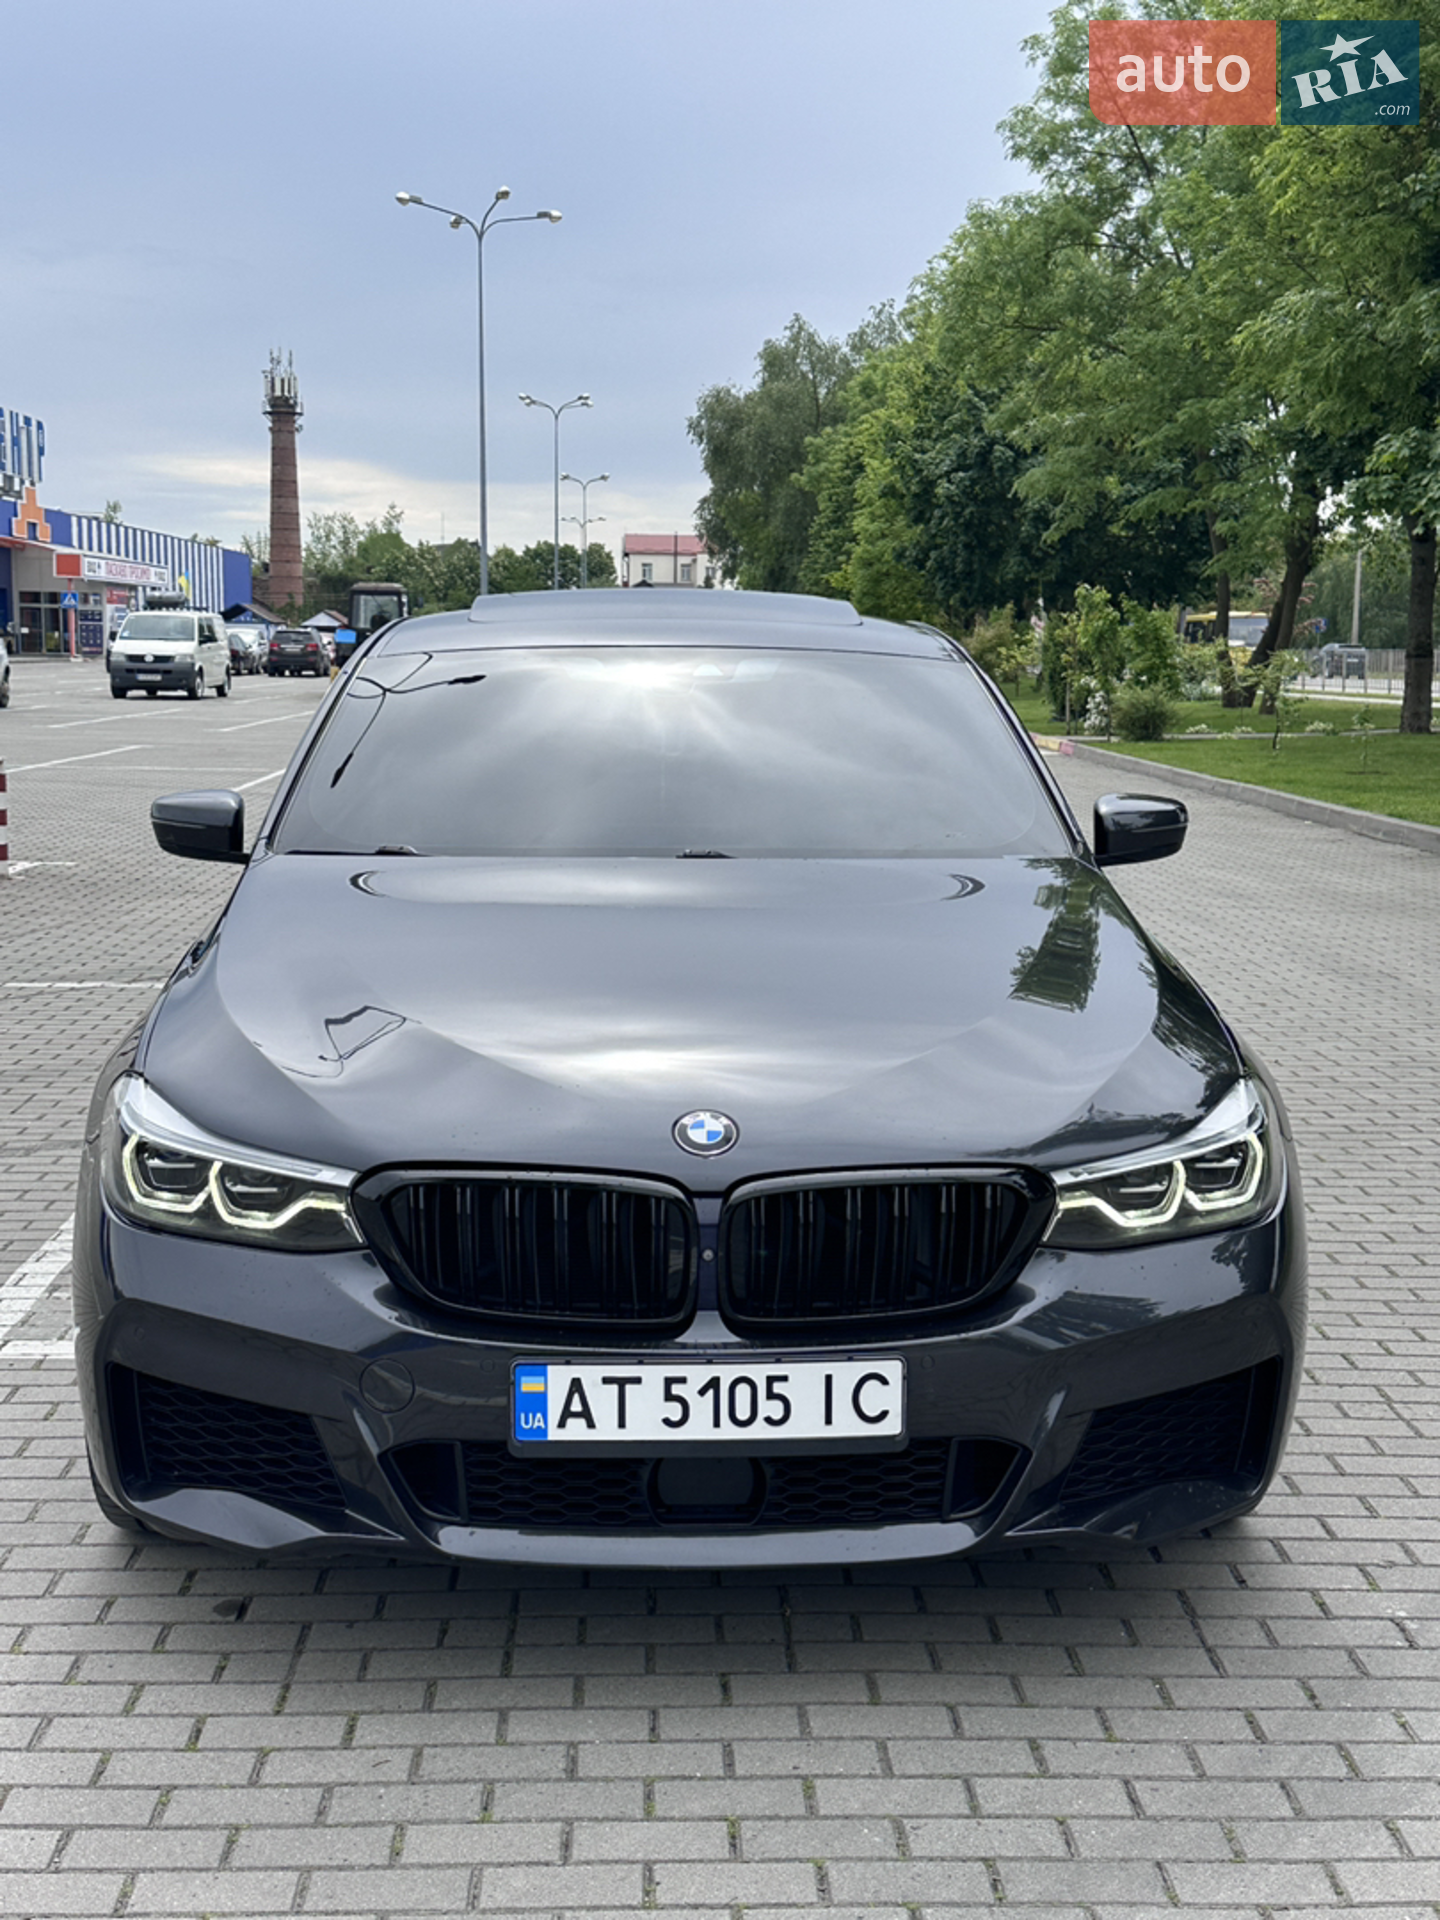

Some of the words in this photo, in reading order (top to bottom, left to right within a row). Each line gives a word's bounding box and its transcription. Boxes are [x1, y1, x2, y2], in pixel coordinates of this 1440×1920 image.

[556, 1375, 642, 1430] AT
[661, 1374, 792, 1429] 5105
[824, 1371, 891, 1426] IC
[520, 1412, 545, 1429] UA
